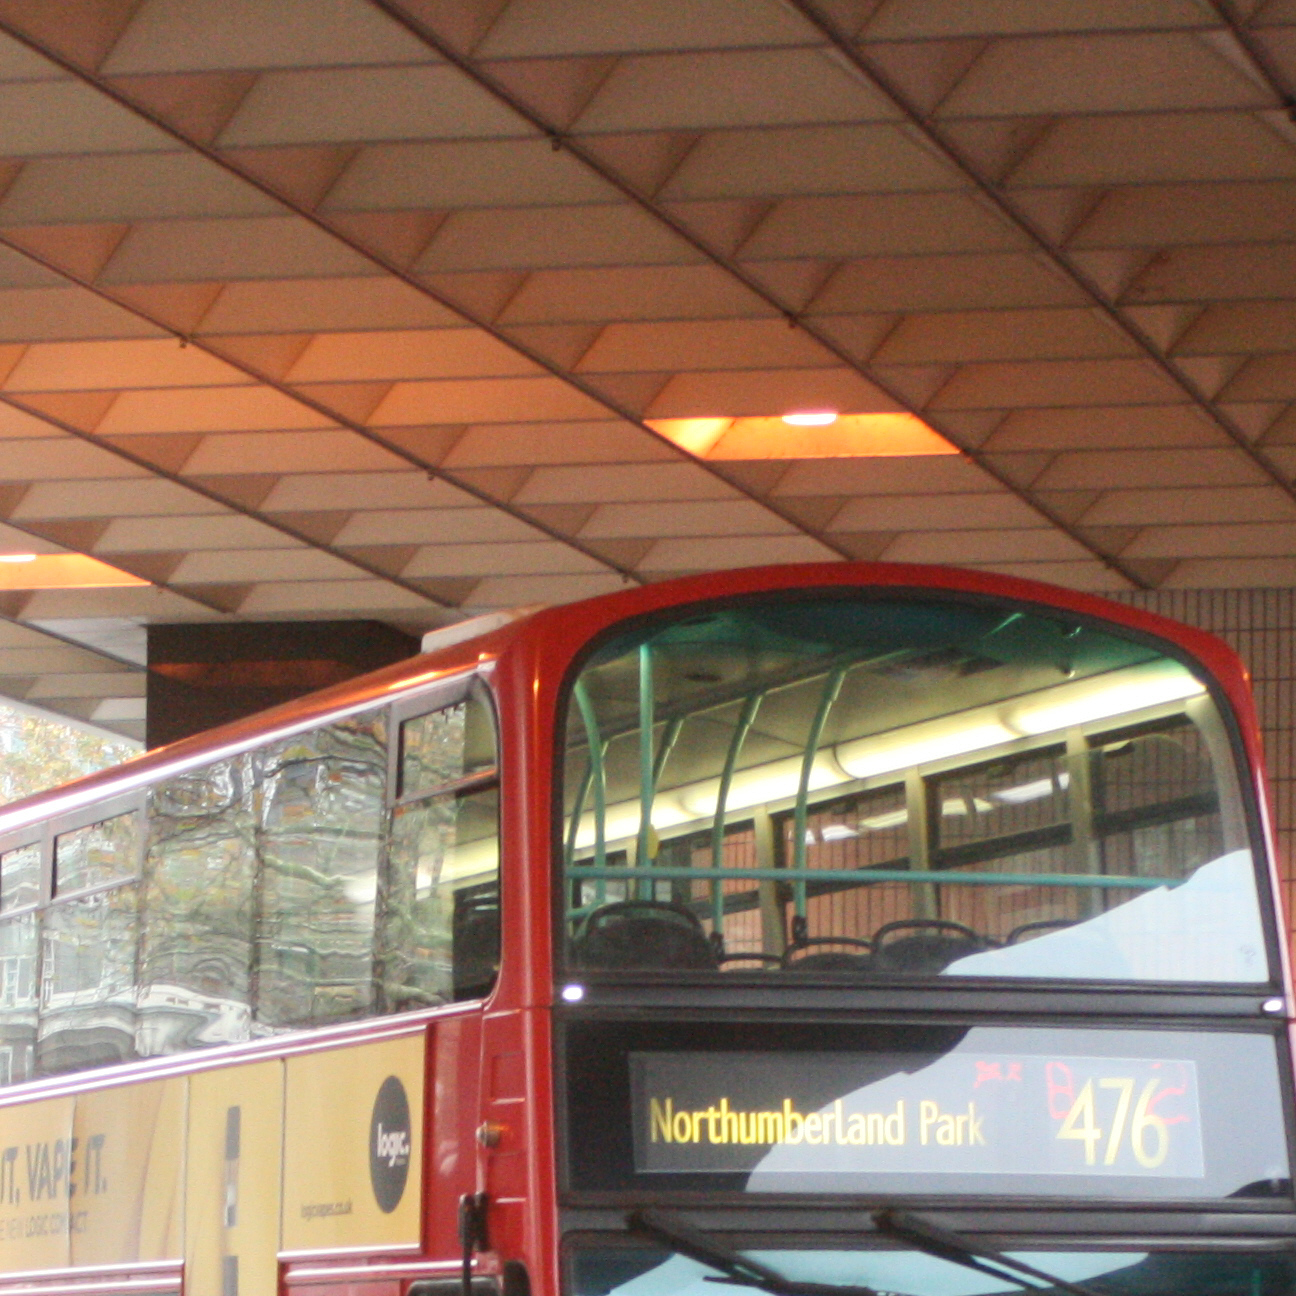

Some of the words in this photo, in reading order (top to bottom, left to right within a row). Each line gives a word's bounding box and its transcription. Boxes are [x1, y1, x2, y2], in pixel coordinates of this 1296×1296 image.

[650, 1098, 905, 1146] Northumberland
[919, 1099, 986, 1147] Park
[1057, 1077, 1169, 1169] 476
[26, 1137, 80, 1202] VAPE
